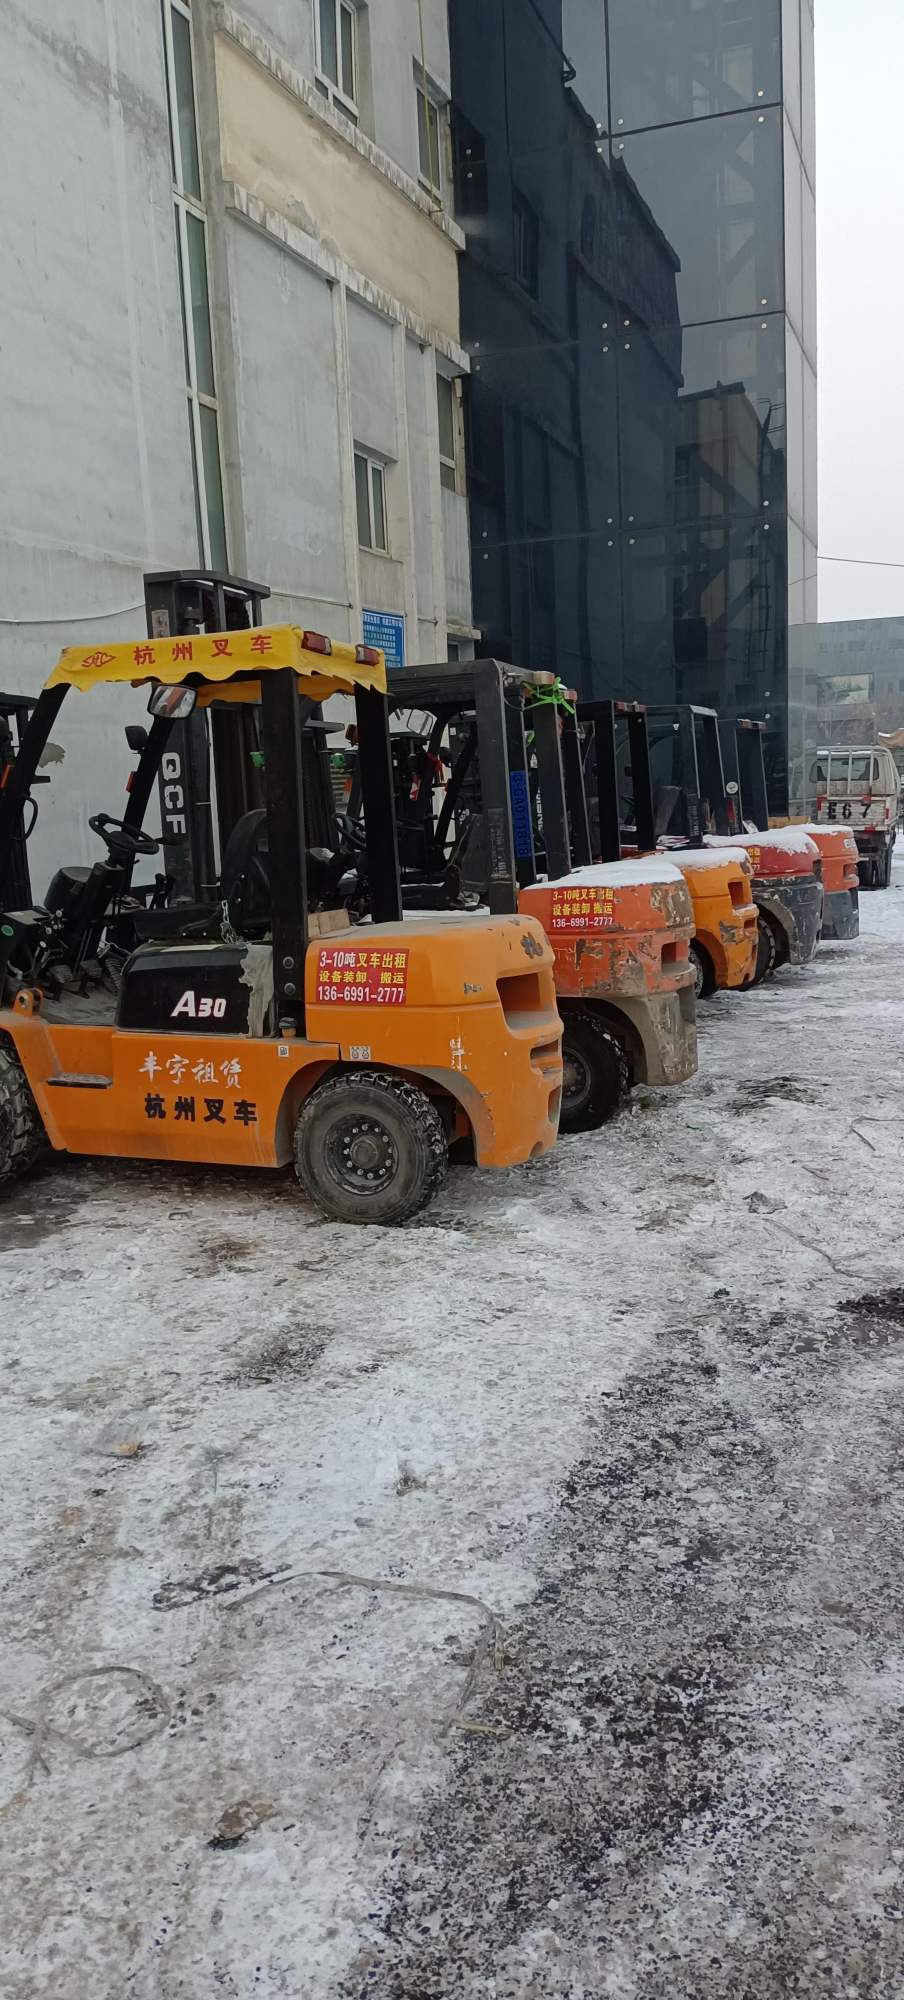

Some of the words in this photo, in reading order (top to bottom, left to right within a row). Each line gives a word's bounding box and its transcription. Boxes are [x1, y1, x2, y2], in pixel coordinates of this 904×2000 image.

[133, 635, 272, 666] 杭州叉车
[161, 752, 186, 834] QCF
[552, 917, 613, 928] 136-6991-2777
[319, 951, 406, 969] 3-10吨叉车出租
[170, 990, 227, 1018] A30
[318, 985, 404, 1003] 136-6991-2777
[144, 1093, 257, 1126] 杭州叉车
